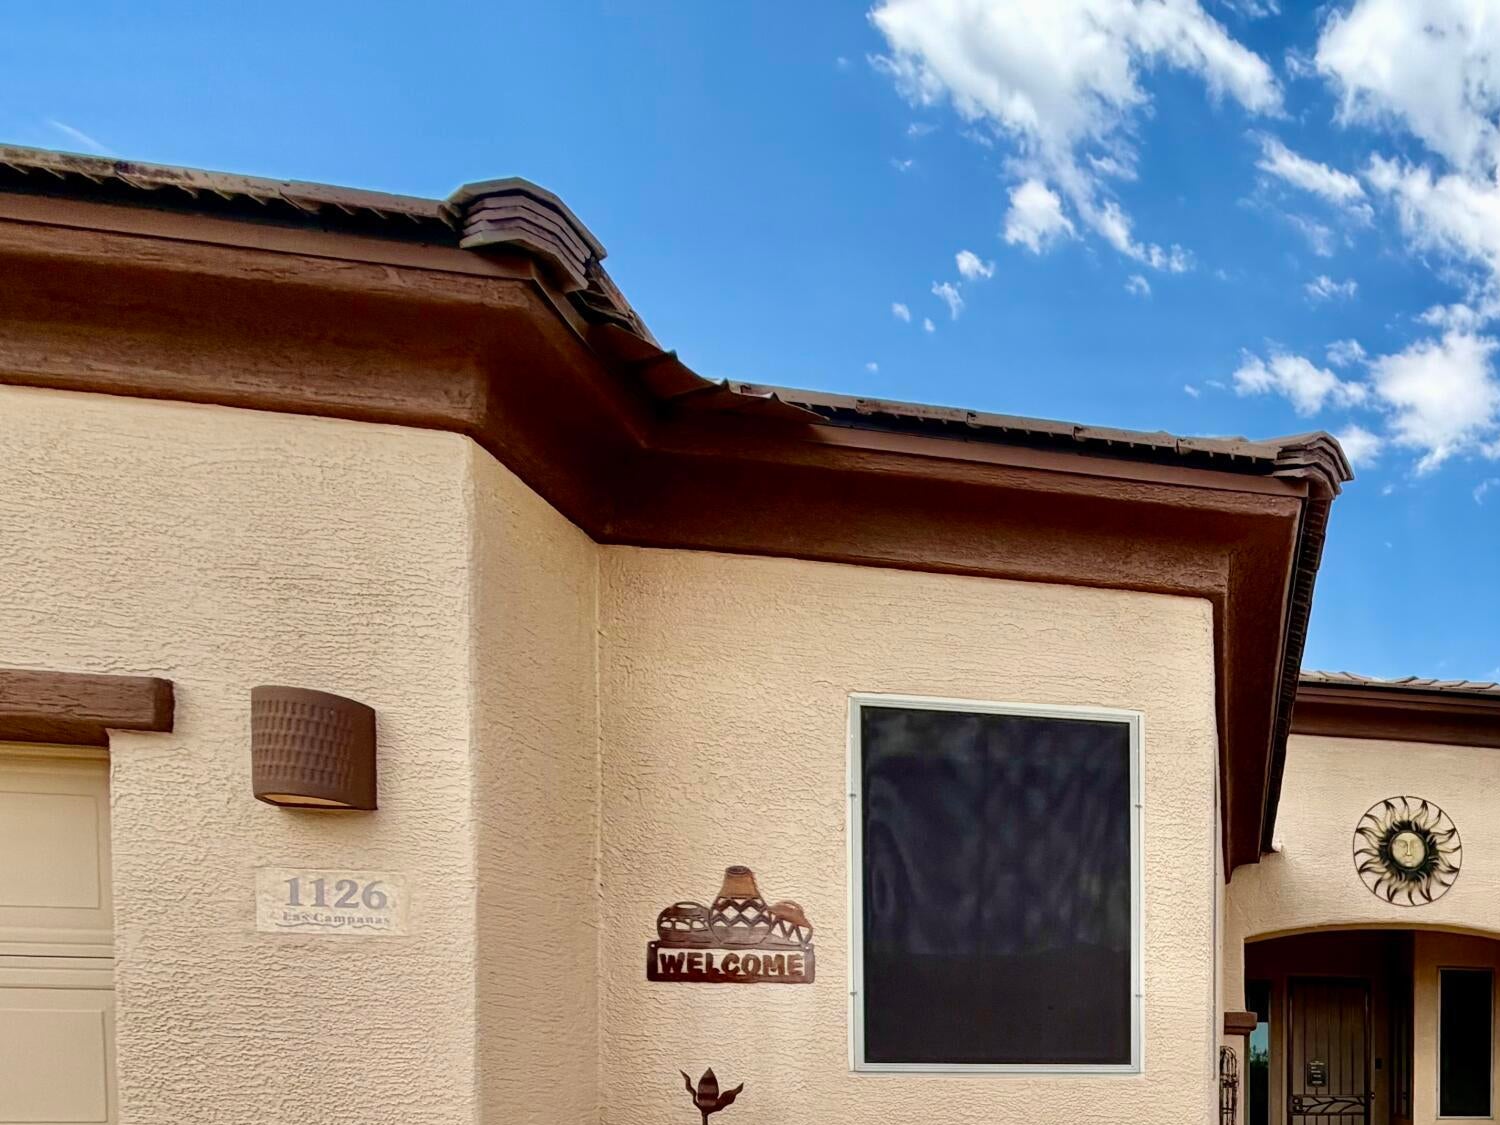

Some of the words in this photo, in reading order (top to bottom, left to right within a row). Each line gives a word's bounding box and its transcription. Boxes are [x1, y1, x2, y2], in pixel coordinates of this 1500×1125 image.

[284, 877, 388, 910] 1126
[313, 912, 390, 925] Campanas
[659, 952, 804, 976] WELCOME
